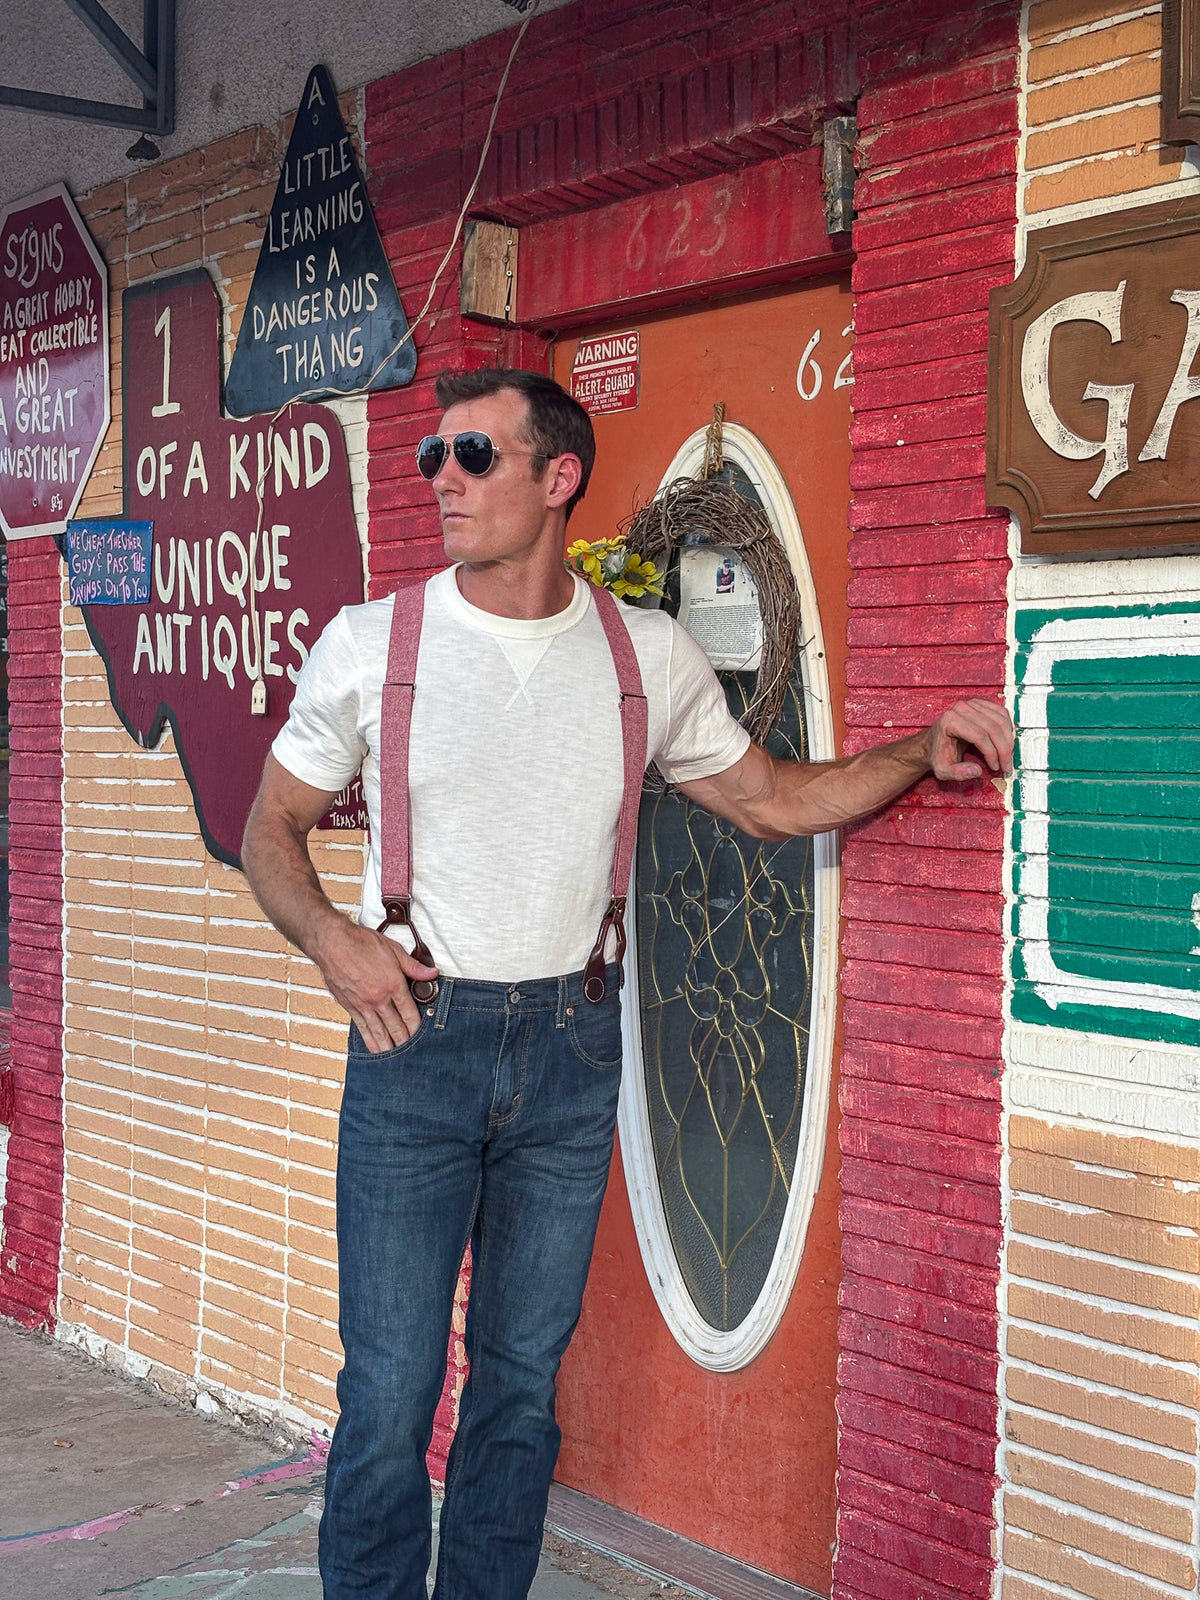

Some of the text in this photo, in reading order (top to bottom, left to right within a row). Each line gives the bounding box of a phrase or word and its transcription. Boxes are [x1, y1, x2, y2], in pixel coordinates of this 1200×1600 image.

[307, 76, 325, 109] A
[283, 136, 351, 194] LITTLE
[268, 181, 364, 253] LEARNING
[625, 188, 732, 272] 623
[296, 247, 341, 289] IS A
[4, 301, 13, 329] A
[15, 291, 49, 328] GREAT
[253, 273, 379, 342] DANGEROUS
[0, 330, 26, 362] EAT
[151, 306, 181, 418] 1
[276, 327, 364, 384] THANG
[575, 336, 637, 365] WARNING
[15, 358, 49, 398] AND
[575, 373, 635, 398] ALERT-GUARD
[16, 388, 78, 434] GREAT
[0, 443, 80, 484] NVESTMENT
[137, 423, 330, 499] OF A KIND
[69, 532, 80, 550] WE
[82, 529, 107, 552] CHEAT
[107, 528, 121, 550] THE
[72, 554, 95, 576] GUY
[107, 553, 128, 574] PASS
[131, 552, 146, 573] THE
[155, 524, 291, 611] UNIQUE
[105, 578, 118, 598] ON
[119, 575, 131, 604] TO
[132, 577, 147, 601] YOU
[133, 608, 309, 690] ANTIQUES
[329, 812, 356, 828] TEXAS
